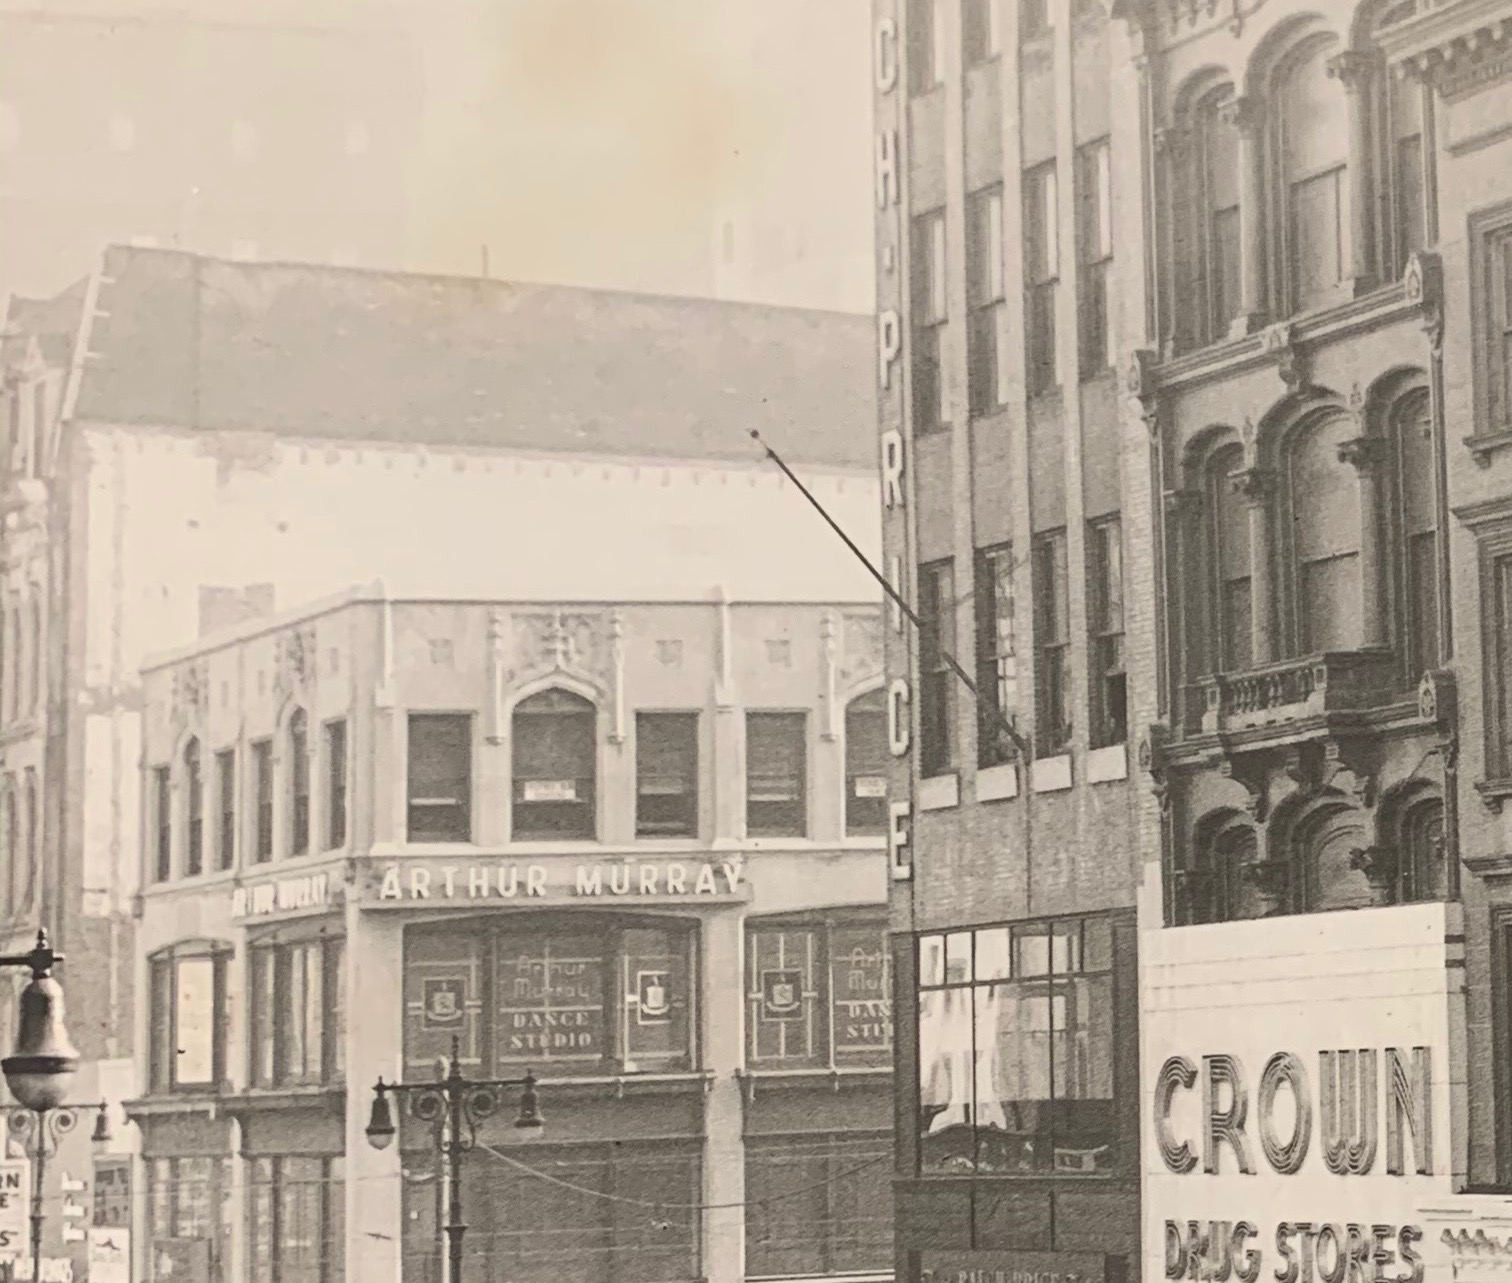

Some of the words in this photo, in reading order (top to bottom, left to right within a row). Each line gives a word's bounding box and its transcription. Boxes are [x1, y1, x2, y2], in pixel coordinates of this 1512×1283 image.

[380, 864, 548, 900] ARTHUR
[576, 861, 744, 897] MURRAY
[513, 1011, 589, 1029] DANCE
[510, 1031, 592, 1050] STUDIO
[1154, 1046, 1434, 1176] CROWN
[1163, 1219, 1261, 1283] DRUG
